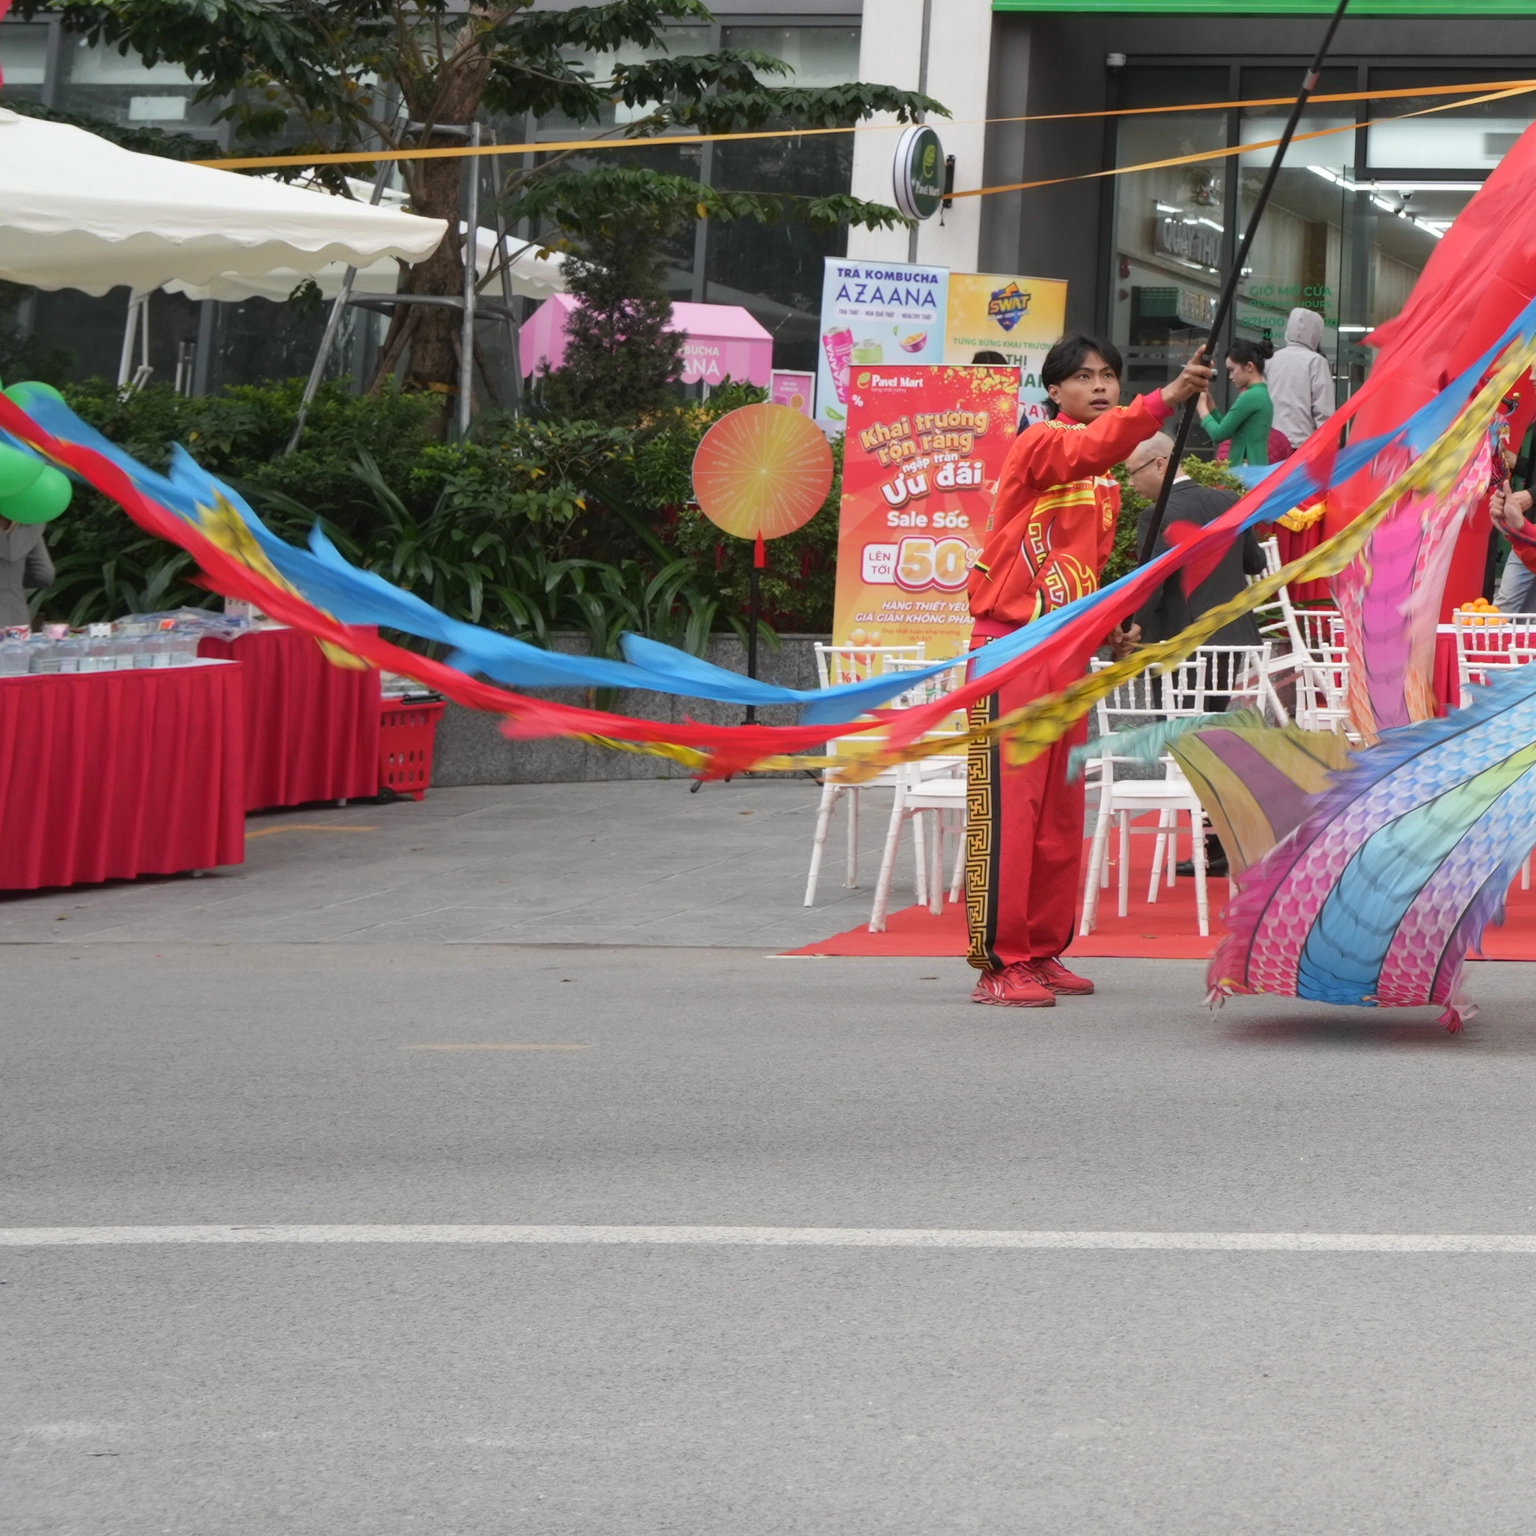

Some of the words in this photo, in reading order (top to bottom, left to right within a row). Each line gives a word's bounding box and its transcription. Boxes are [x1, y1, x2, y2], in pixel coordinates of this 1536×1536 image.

[865, 269, 939, 284] KOMBUCHA
[835, 283, 938, 309] AZAANA
[988, 293, 1032, 315] SWAT
[1002, 339, 1022, 349] KHAI
[1022, 340, 1054, 352] TRƯƠN
[871, 374, 898, 388] Pavel
[899, 376, 924, 388] Mart
[860, 416, 909, 451] Khai
[914, 410, 989, 438] trương
[878, 440, 917, 467] rộn
[921, 428, 974, 456] ràng
[902, 456, 930, 475] ngập
[933, 450, 958, 464] tràn
[936, 461, 983, 488] đãi
[886, 511, 927, 529] Sale
[932, 509, 970, 529] Sốc
[868, 550, 891, 562] LÊN
[871, 563, 891, 575] TỚI
[882, 600, 913, 612] HÀNG
[915, 599, 948, 612] THIẾT
[949, 600, 970, 612] YẾU
[855, 611, 875, 623] GIÁ
[876, 611, 905, 624] GIẢM
[905, 612, 946, 625] KHÔNG
